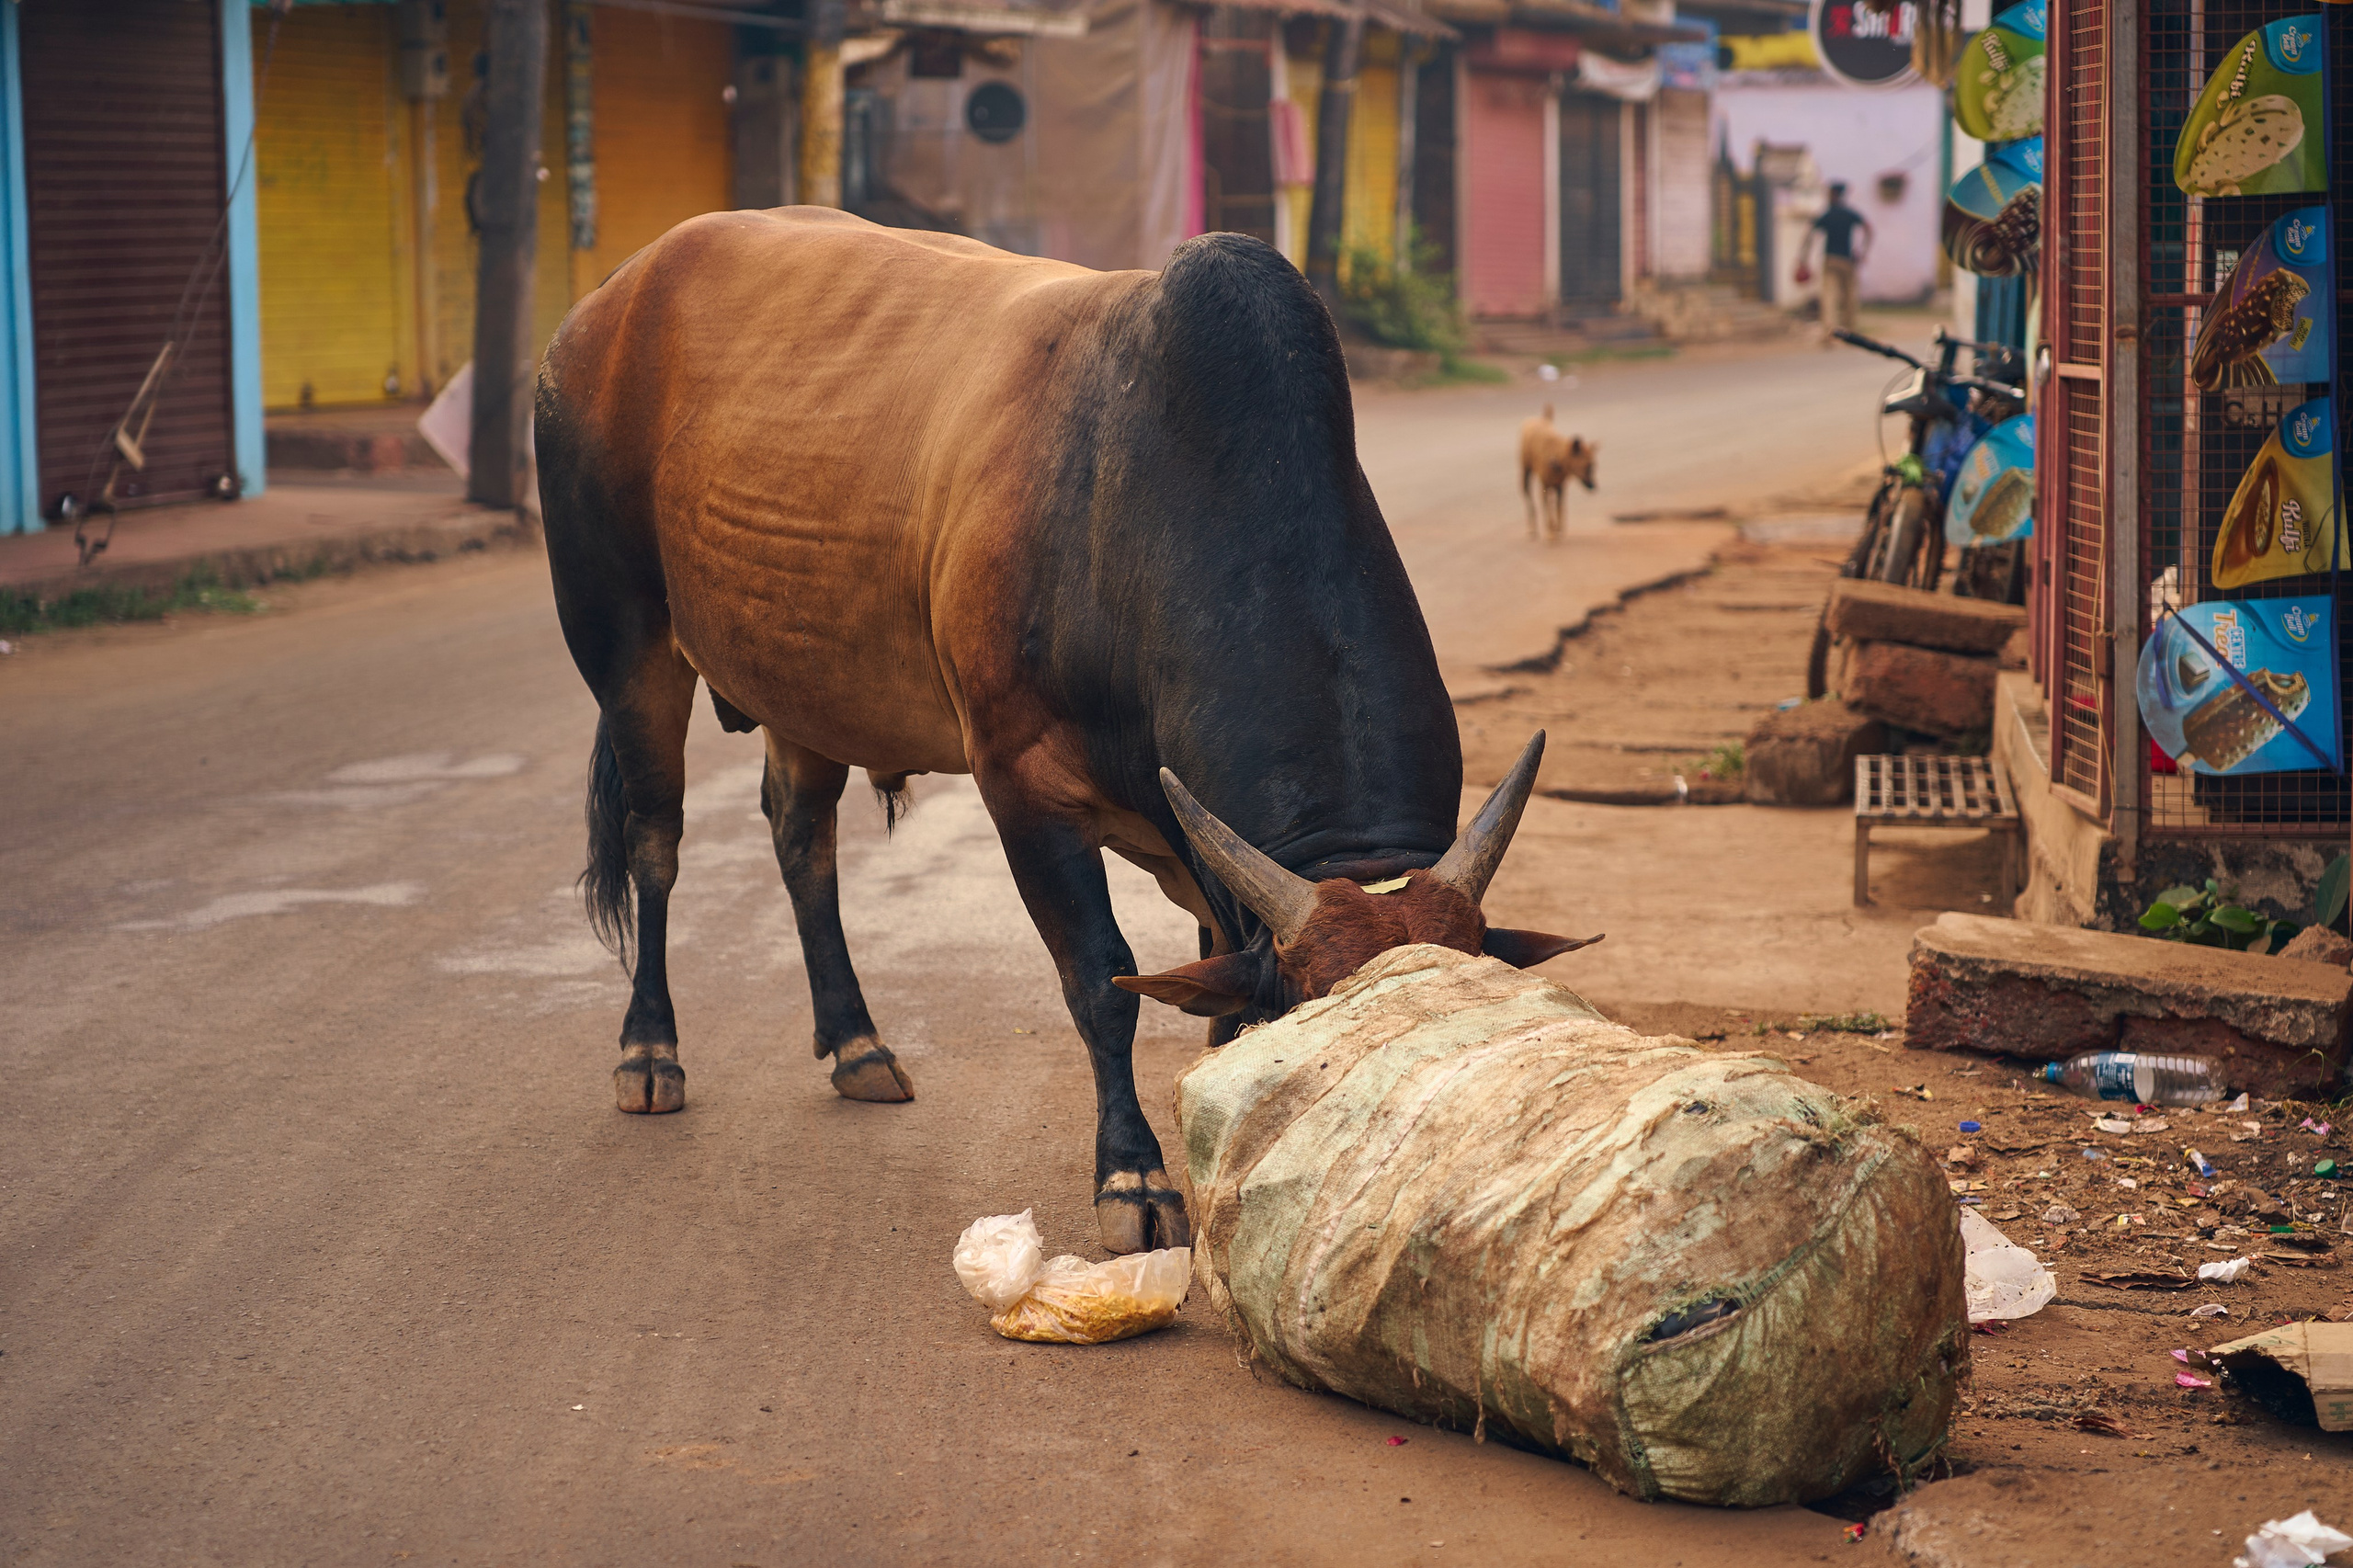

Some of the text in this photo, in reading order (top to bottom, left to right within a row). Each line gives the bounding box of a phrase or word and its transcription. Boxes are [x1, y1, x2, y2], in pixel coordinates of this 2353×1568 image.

[2230, 39, 2256, 98] Kulfi
[2279, 499, 2302, 553] Kulfi
[2213, 608, 2236, 669] Trea
